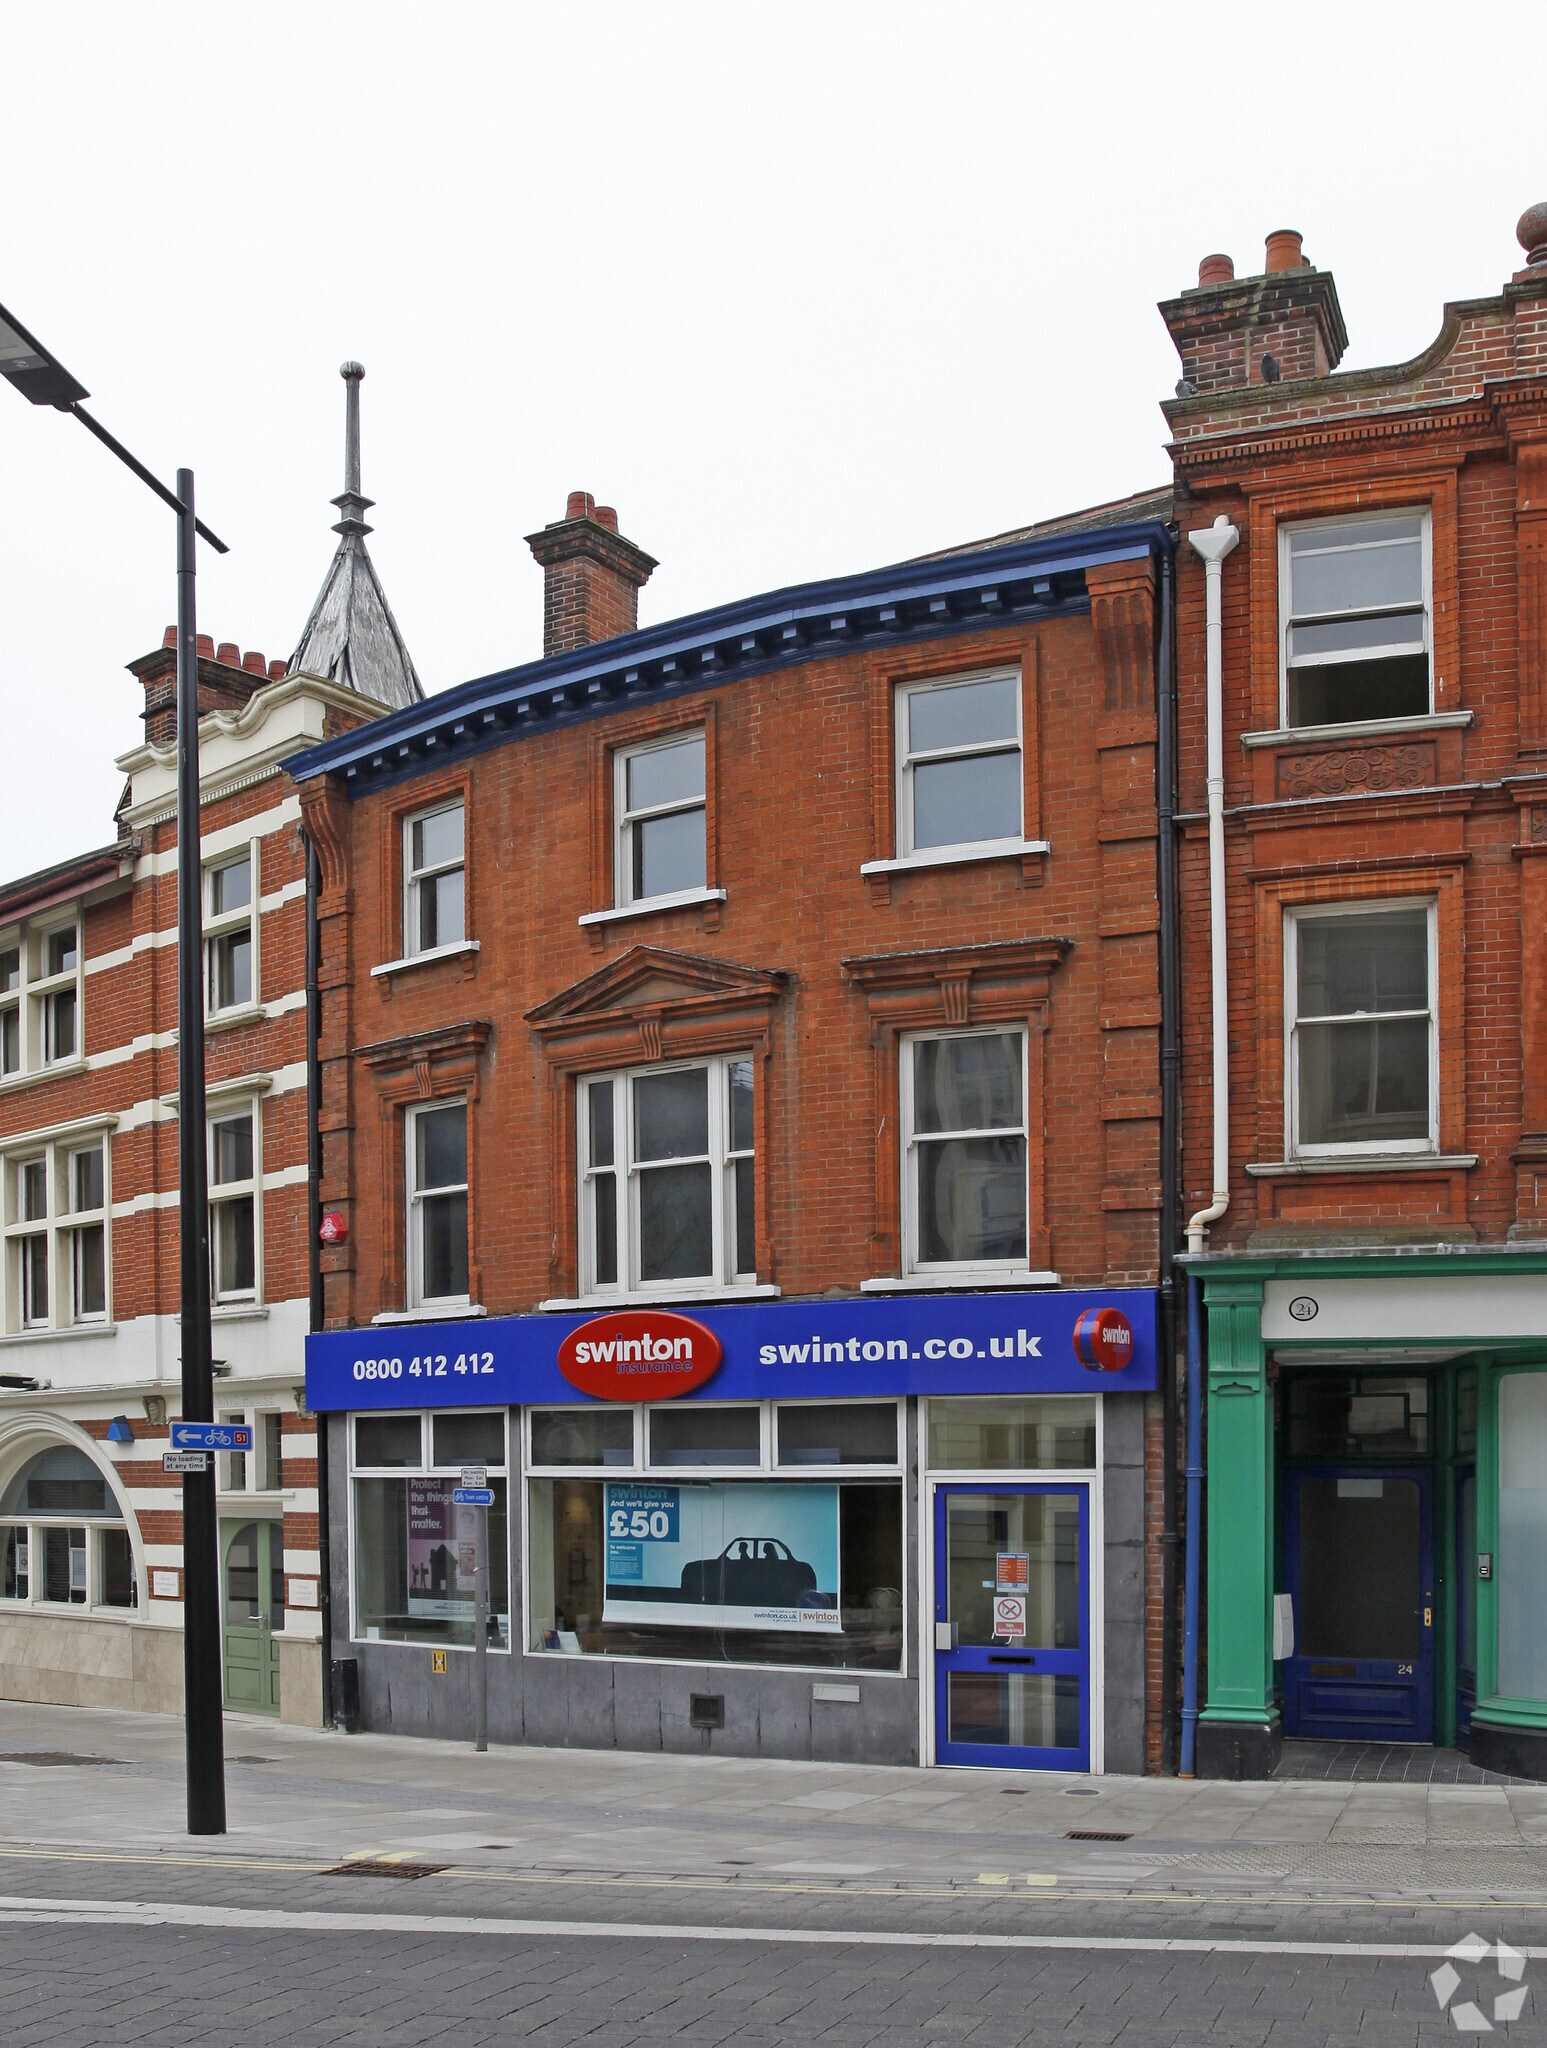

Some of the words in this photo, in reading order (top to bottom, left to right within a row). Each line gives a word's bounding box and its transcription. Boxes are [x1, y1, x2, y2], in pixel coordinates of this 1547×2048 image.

[1296, 1302, 1312, 1316] 24
[1102, 1325, 1130, 1345] swinton
[575, 1333, 692, 1363] swinton
[759, 1328, 1042, 1365] swinton.co.uk
[353, 1358, 403, 1380] 0800
[408, 1355, 448, 1377] 412
[453, 1352, 494, 1375] 412
[617, 1361, 692, 1374] insurance
[236, 1434, 246, 1442] 51
[411, 1479, 441, 1489] Protect
[411, 1492, 425, 1502] the
[426, 1492, 453, 1505] things
[610, 1485, 668, 1499] swinton
[644, 1501, 659, 1509] give
[411, 1519, 442, 1529] matter.
[609, 1510, 669, 1539] £50
[754, 1612, 798, 1620] swinton.co.uk
[803, 1612, 839, 1621] swinton
[1398, 1664, 1412, 1674] 24
